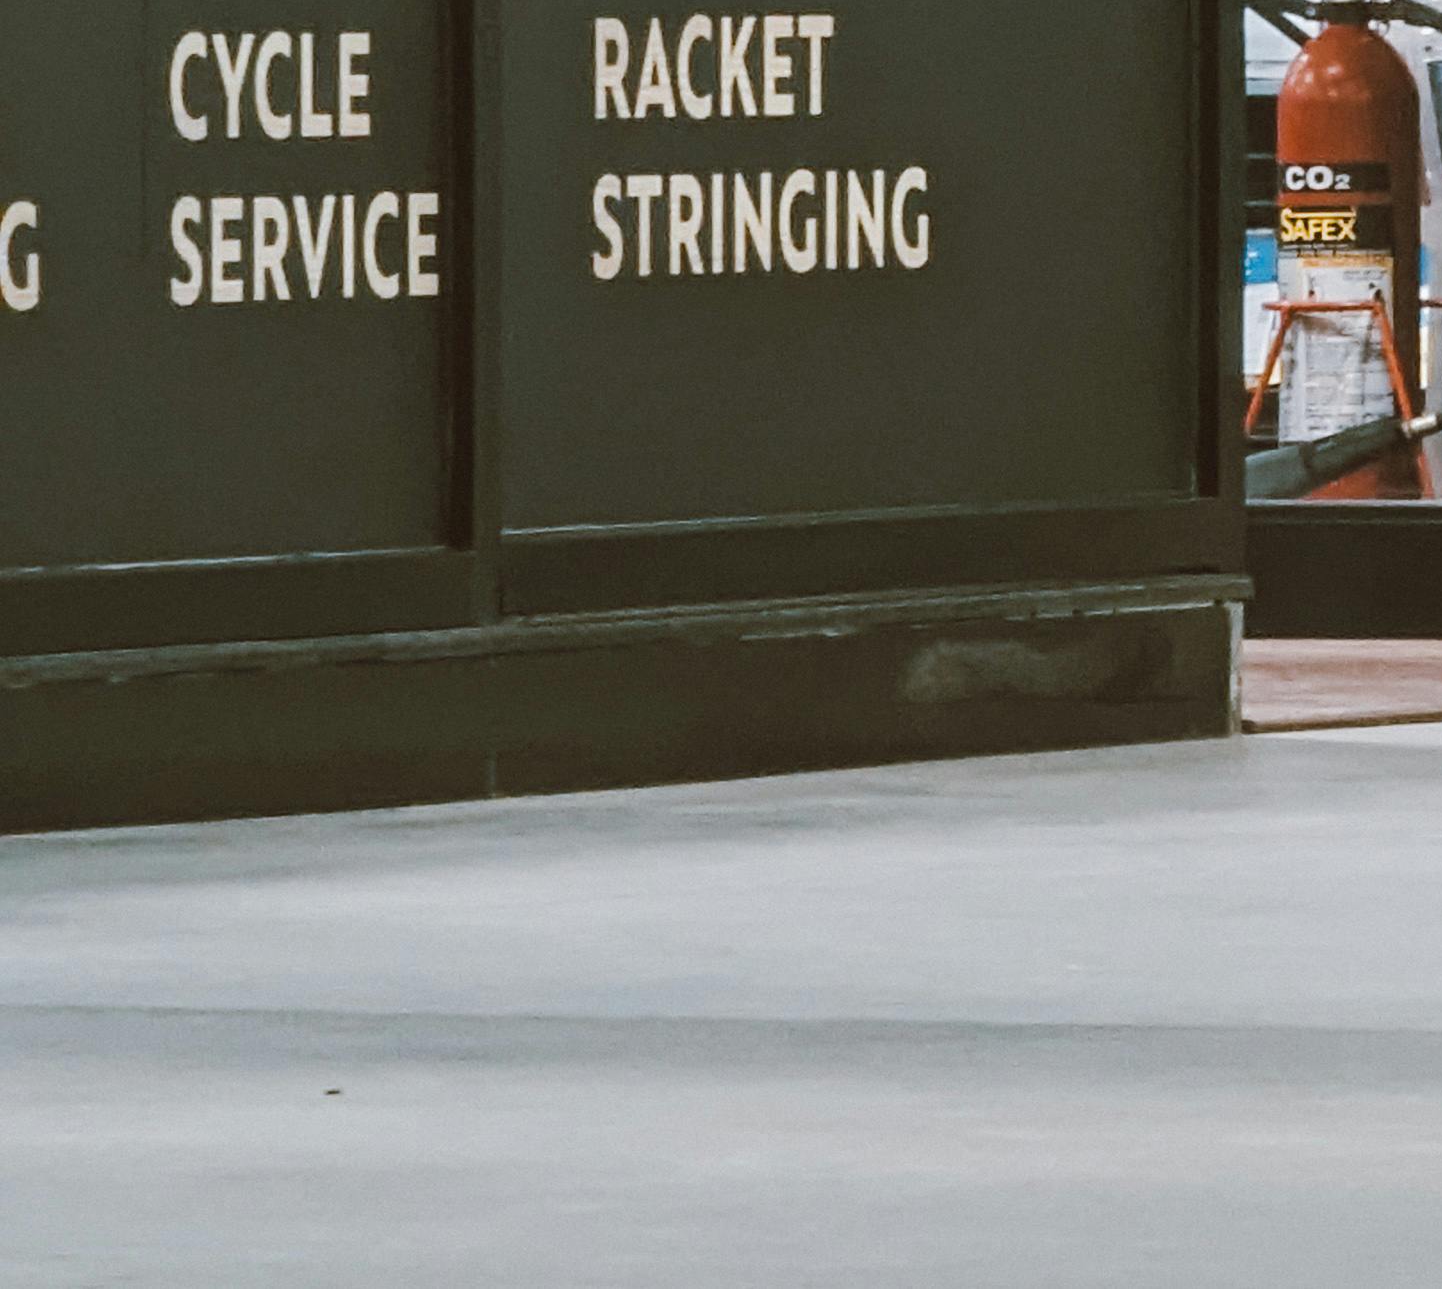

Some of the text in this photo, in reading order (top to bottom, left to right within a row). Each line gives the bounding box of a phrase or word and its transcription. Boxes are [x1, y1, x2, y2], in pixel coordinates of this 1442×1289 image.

[170, 31, 371, 140] CYCLE
[594, 14, 834, 119] RACKET
[170, 192, 440, 306] SERVICE
[592, 167, 930, 280] STRINGING
[1280, 206, 1357, 242] SAFEX
